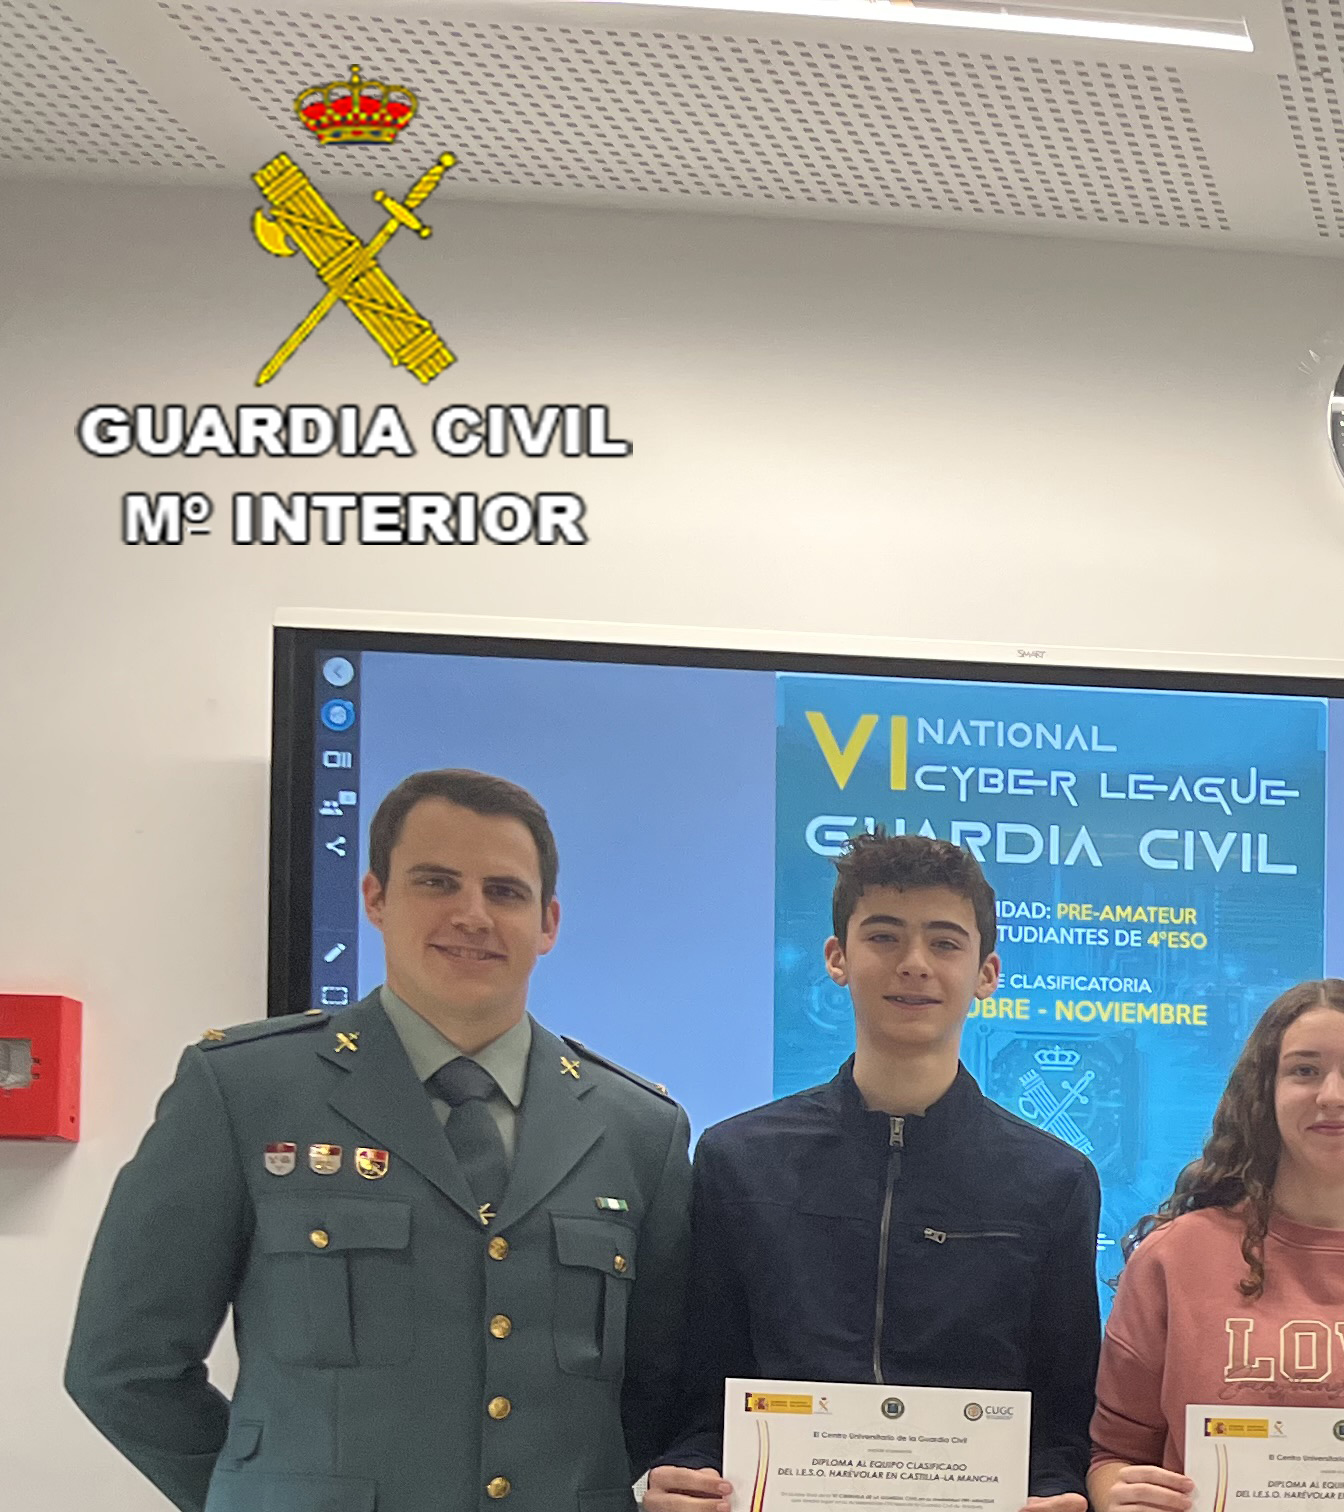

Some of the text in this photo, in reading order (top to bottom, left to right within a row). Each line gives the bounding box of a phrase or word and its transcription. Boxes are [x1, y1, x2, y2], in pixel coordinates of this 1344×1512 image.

[917, 716, 1118, 753] NATIONAL
[805, 710, 908, 790] VI
[914, 765, 1300, 816] CYBER LEAGUE
[1138, 828, 1299, 875] CIVIL
[995, 900, 1198, 925] IDAD: PRE-AMATEUR
[996, 924, 1110, 947] TUDIANTES
[1115, 929, 1143, 948] DE
[1009, 972, 1153, 994] CLASIFICATORIA
[966, 996, 1031, 1020] UBRE
[1054, 999, 1209, 1026] NOVIEMBRE
[985, 1406, 1014, 1416] CUGC
[778, 1468, 794, 1476] DEL
[886, 1472, 898, 1480] EN
[957, 1474, 1000, 1483] MANCHA
[812, 1458, 968, 1472] DIPLOMA AL EQUIPO CLASIFICADO
[1235, 1490, 1250, 1498] DEL
[1267, 1480, 1307, 1488] DIPLOMA
[1309, 1481, 1320, 1489] AL
